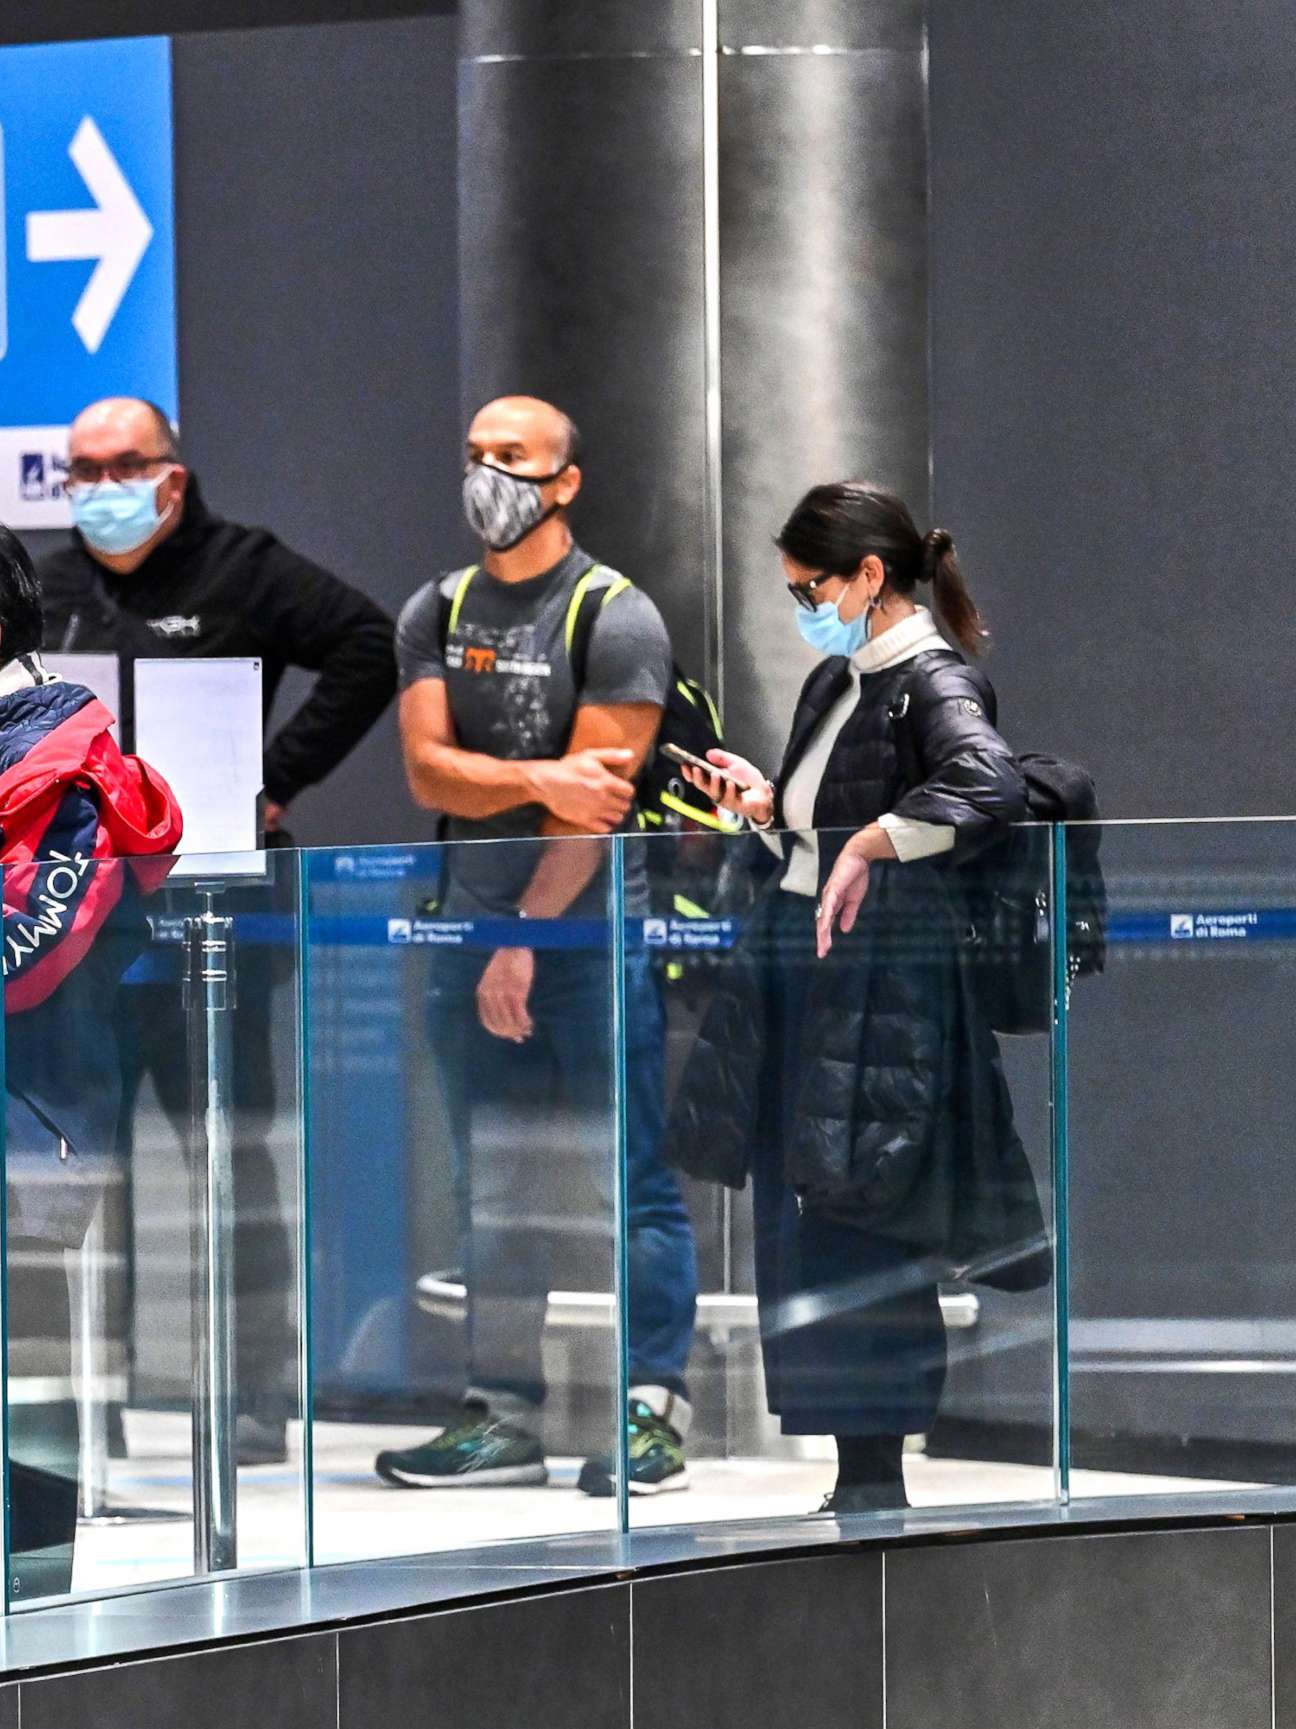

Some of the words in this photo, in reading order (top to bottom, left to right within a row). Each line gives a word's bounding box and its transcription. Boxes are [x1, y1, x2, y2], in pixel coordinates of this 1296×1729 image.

[6, 849, 90, 968] TOMMY
[1196, 912, 1258, 927] Aeroporti
[1196, 926, 1209, 938] di
[1210, 926, 1247, 938] Roma
